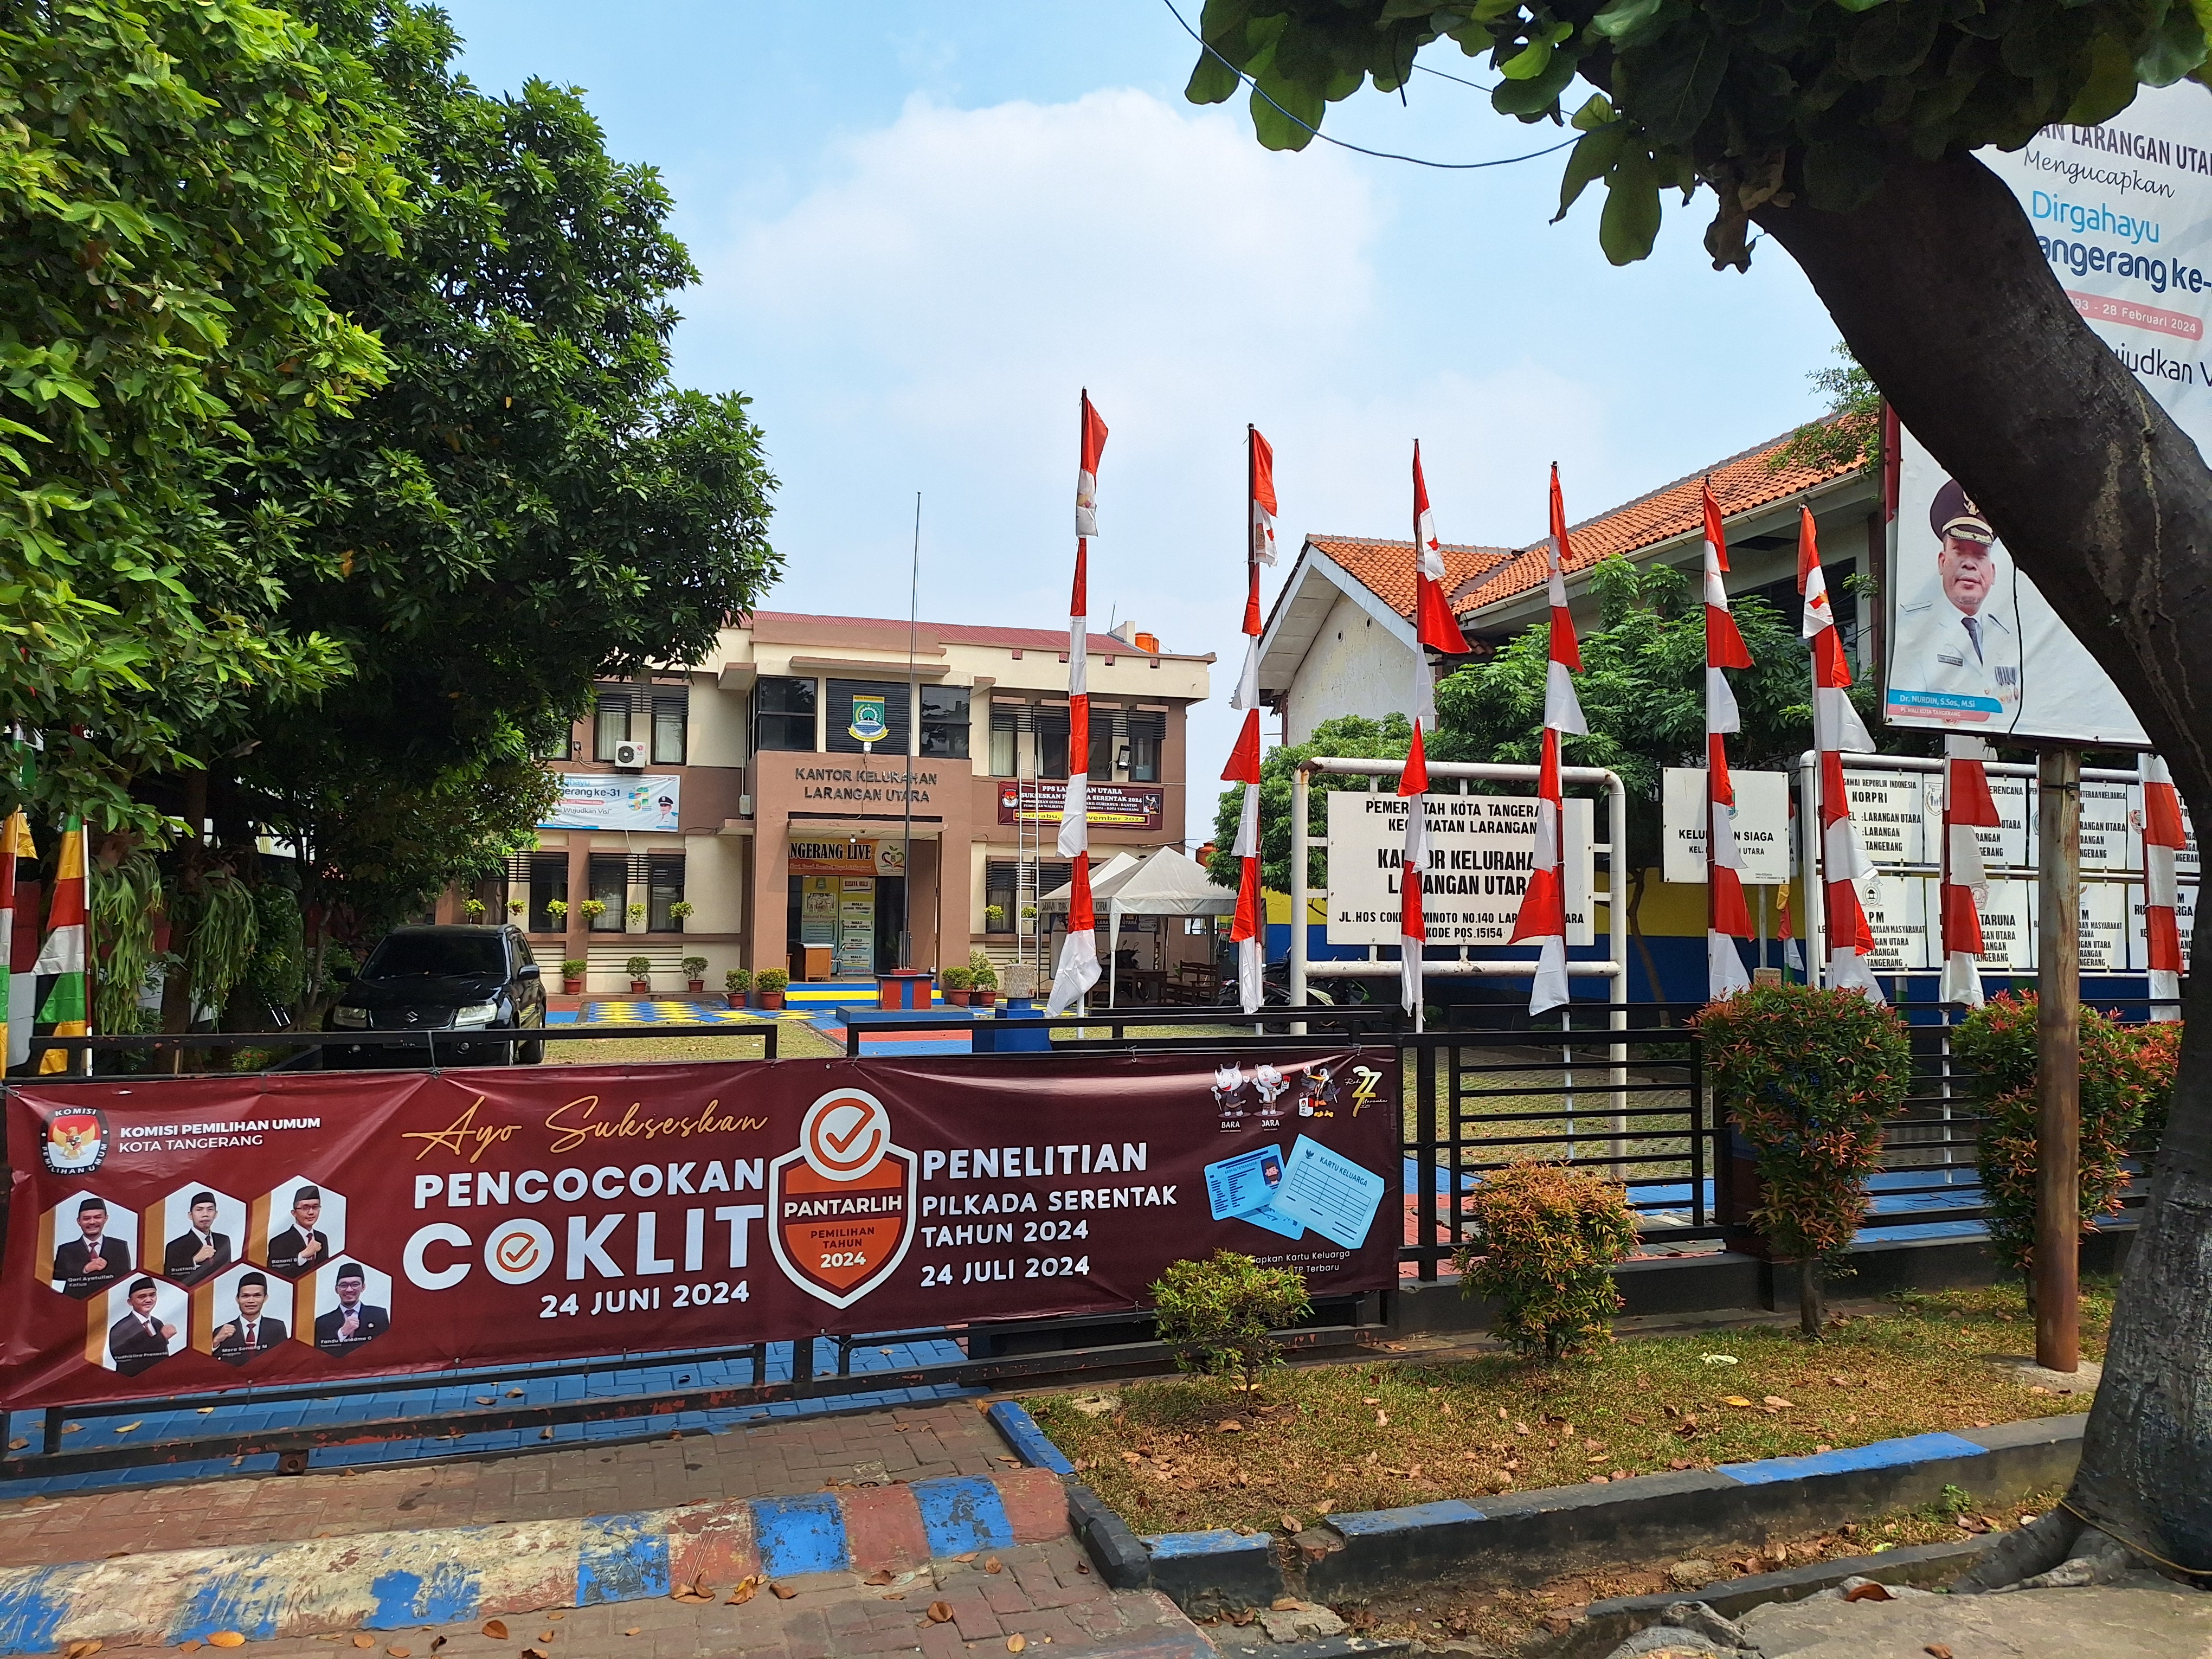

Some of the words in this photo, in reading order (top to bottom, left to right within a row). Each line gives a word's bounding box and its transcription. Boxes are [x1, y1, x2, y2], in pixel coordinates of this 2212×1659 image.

[2072, 124, 2170, 166] LARANGAN
[2176, 144, 2212, 176] UTA
[2024, 146, 2176, 198] Mengucapkan
[2033, 190, 2159, 245] Dirgahayu
[2037, 235, 2166, 293] angerang
[2172, 258, 2212, 293] ke-
[2102, 304, 2117, 316] 28
[2171, 318, 2196, 333] 2024
[2115, 343, 2192, 384] judkan
[1912, 696, 1939, 705] NURDIN,
[795, 768, 852, 781] KANTOR
[857, 770, 937, 785] KELURAHAN
[1862, 779, 1887, 787] REPUBLIK
[1889, 780, 1917, 789] INDONESIA
[1989, 786, 2023, 795] ERENCANA
[595, 788, 620, 796] ke-31
[805, 786, 882, 801] LARANGAN
[886, 789, 930, 802] UTARA
[1852, 792, 1887, 803] KORPRI
[1366, 801, 1445, 815] PEMERTAH
[1451, 803, 1481, 816] KOTA
[1487, 804, 1539, 818] TANGER
[1901, 814, 1921, 824] UTARA
[2001, 820, 2021, 829] UTARA
[1470, 820, 1537, 834] LARANGAN
[2080, 821, 2104, 831] RANGAN
[2105, 822, 2126, 832] UTARA
[1679, 829, 1740, 841] KELUN
[1744, 832, 1774, 841] SIAGA
[1976, 833, 2001, 843] RANGAN
[2080, 835, 2104, 845] RANGAN
[788, 843, 844, 859] NGERANG
[847, 844, 871, 860] LIVE
[1865, 841, 1902, 852] TANGERANG
[1979, 847, 2003, 857] GERANG
[2080, 849, 2107, 858] NGERANG
[1451, 850, 1536, 871] KELURAHA
[2174, 853, 2198, 863] NGERAN
[1388, 874, 1479, 895] LANGAN
[1484, 876, 1533, 896] UTAR
[1380, 912, 1457, 923] COKMINOTO
[1462, 913, 1494, 923] NO.140
[1565, 913, 1584, 924] ARA
[2176, 906, 2193, 916] RGA
[1979, 914, 2016, 926] TARUNA
[1426, 928, 1450, 938] KODE
[1891, 925, 1925, 934] MASYARAKAT
[1996, 931, 2016, 940] UTARA
[1867, 959, 1902, 967] TANGERANG
[55, 1108, 97, 1116] KOMISI
[120, 1124, 179, 1138] KOMISI
[181, 1119, 269, 1136] PEMILIHAN
[272, 1117, 321, 1130] UMUM
[401, 1095, 523, 1164] Ayo
[545, 1095, 769, 1154] Sukseskan
[119, 1139, 161, 1153] KOTA
[165, 1134, 263, 1150] TANGERANG
[42, 1146, 85, 1174] PEMILIHAN
[88, 1143, 108, 1171] UMUM
[923, 1142, 1147, 1180] PENELITIAN
[1320, 1156, 1340, 1172] KARTU
[1339, 1164, 1368, 1187] KELUARGA
[414, 1158, 764, 1210] PENCOCOKAN
[784, 1195, 903, 1218] PANTARLIH
[923, 1192, 1038, 1217] PILKADA
[1047, 1185, 1178, 1211] SERENTAK
[811, 1226, 875, 1240] PEMILIHAN
[921, 1223, 1013, 1248] TAHUN
[1024, 1219, 1089, 1243] 2024
[403, 1204, 764, 1290] COKLIT
[822, 1238, 863, 1250] TAHUN
[820, 1251, 867, 1269] 2024
[1253, 1255, 1283, 1265] apkan
[1286, 1253, 1309, 1262] Kartu
[1312, 1251, 1350, 1259] Keluarga
[921, 1265, 953, 1287] 24
[963, 1258, 1014, 1285] JULI
[1025, 1255, 1090, 1278] 2024
[1307, 1264, 1340, 1272] Terbaru
[539, 1294, 579, 1319] 24
[590, 1287, 660, 1316] JUNI
[672, 1280, 749, 1308] 2024
